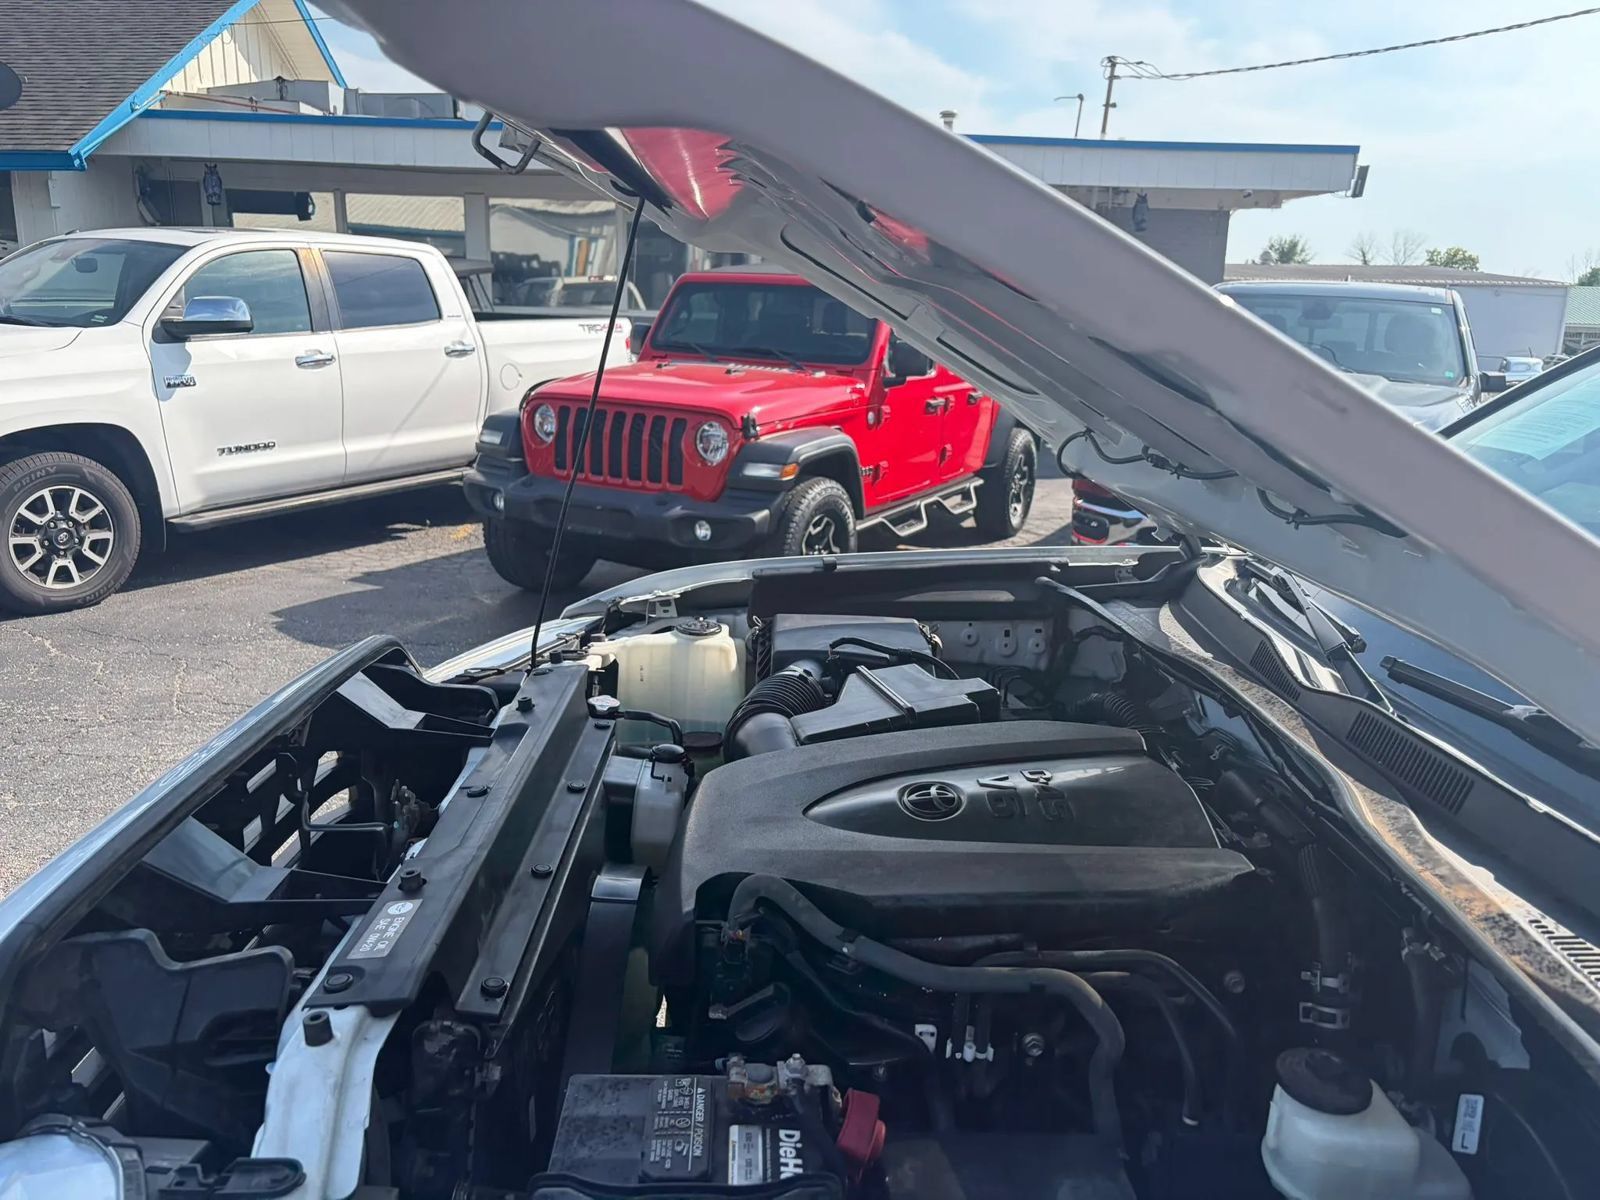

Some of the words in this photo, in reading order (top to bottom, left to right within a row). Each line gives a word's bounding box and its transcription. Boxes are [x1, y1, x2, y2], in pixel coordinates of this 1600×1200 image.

[217, 441, 276, 456] TUNDRA
[694, 1094, 706, 1122] DANGER
[693, 1128, 705, 1157] POISON
